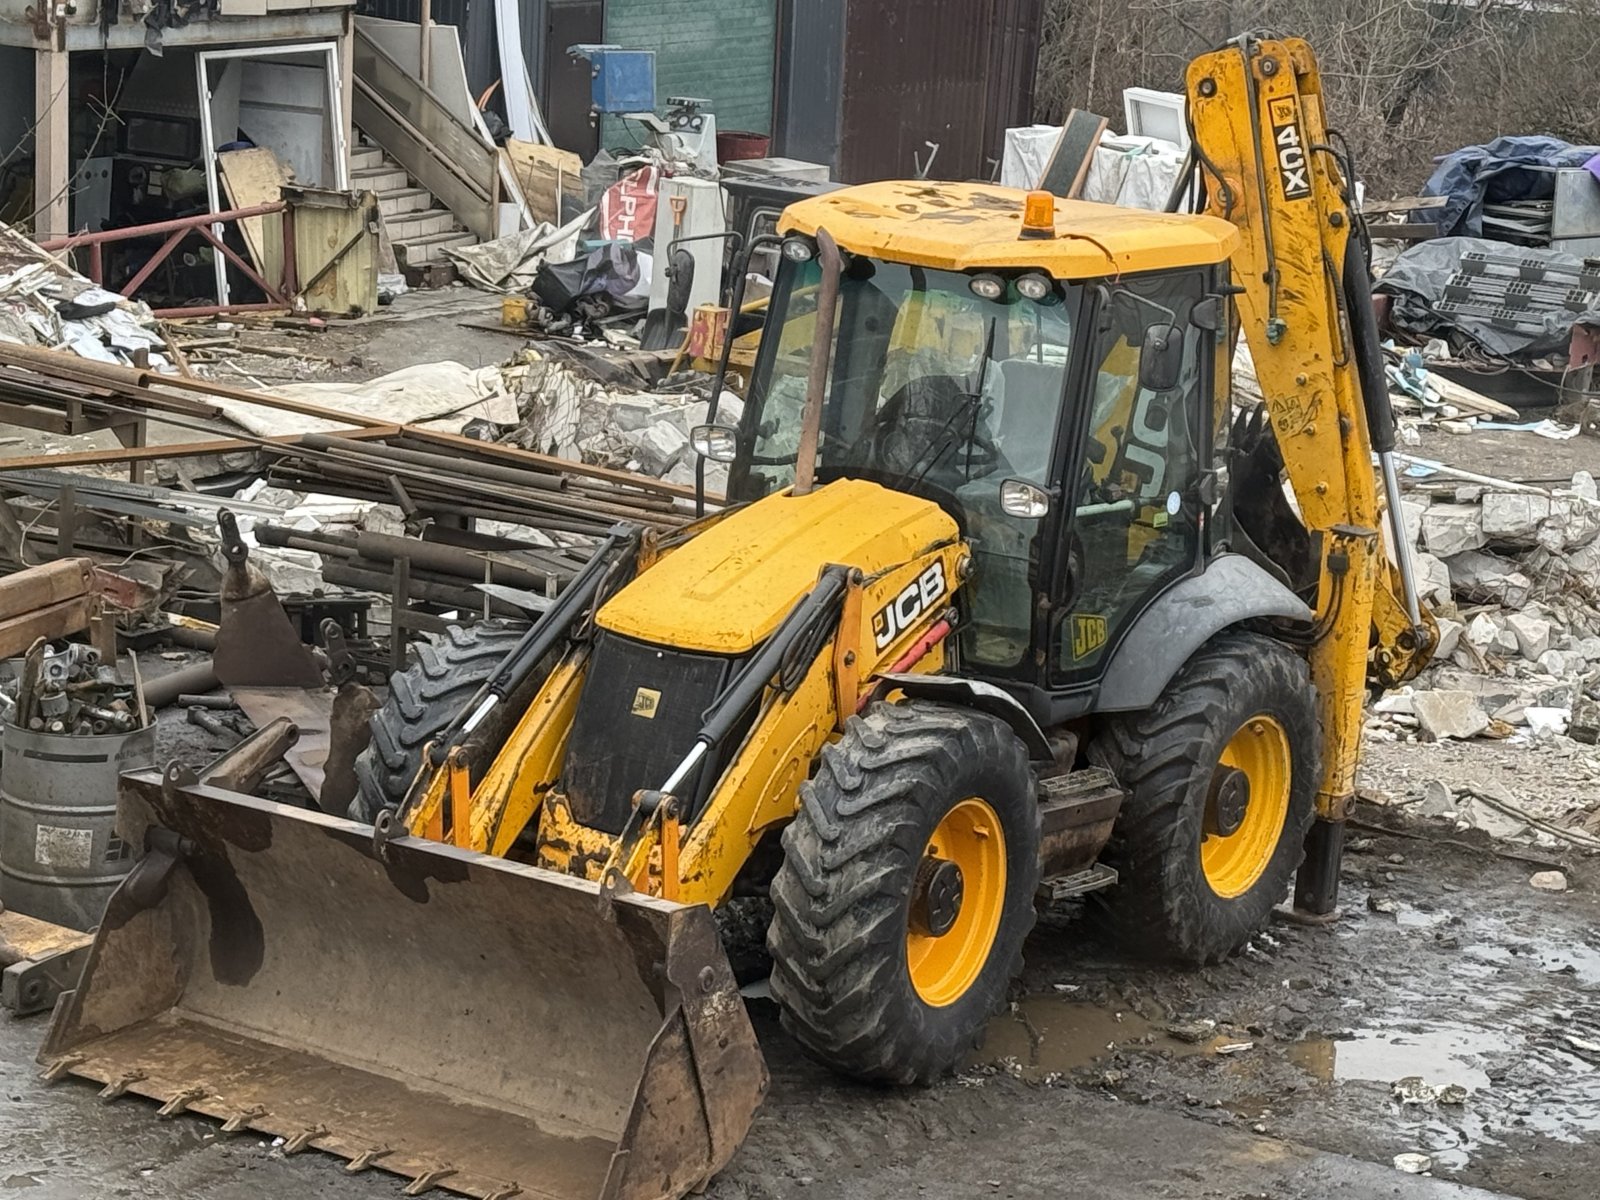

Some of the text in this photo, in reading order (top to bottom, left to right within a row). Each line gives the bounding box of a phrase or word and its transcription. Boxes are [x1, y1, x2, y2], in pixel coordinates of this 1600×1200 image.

[1277, 125, 1309, 193] 4CX
[1124, 387, 1169, 499] JC
[876, 562, 945, 649] JCB
[1075, 618, 1105, 656] JCB
